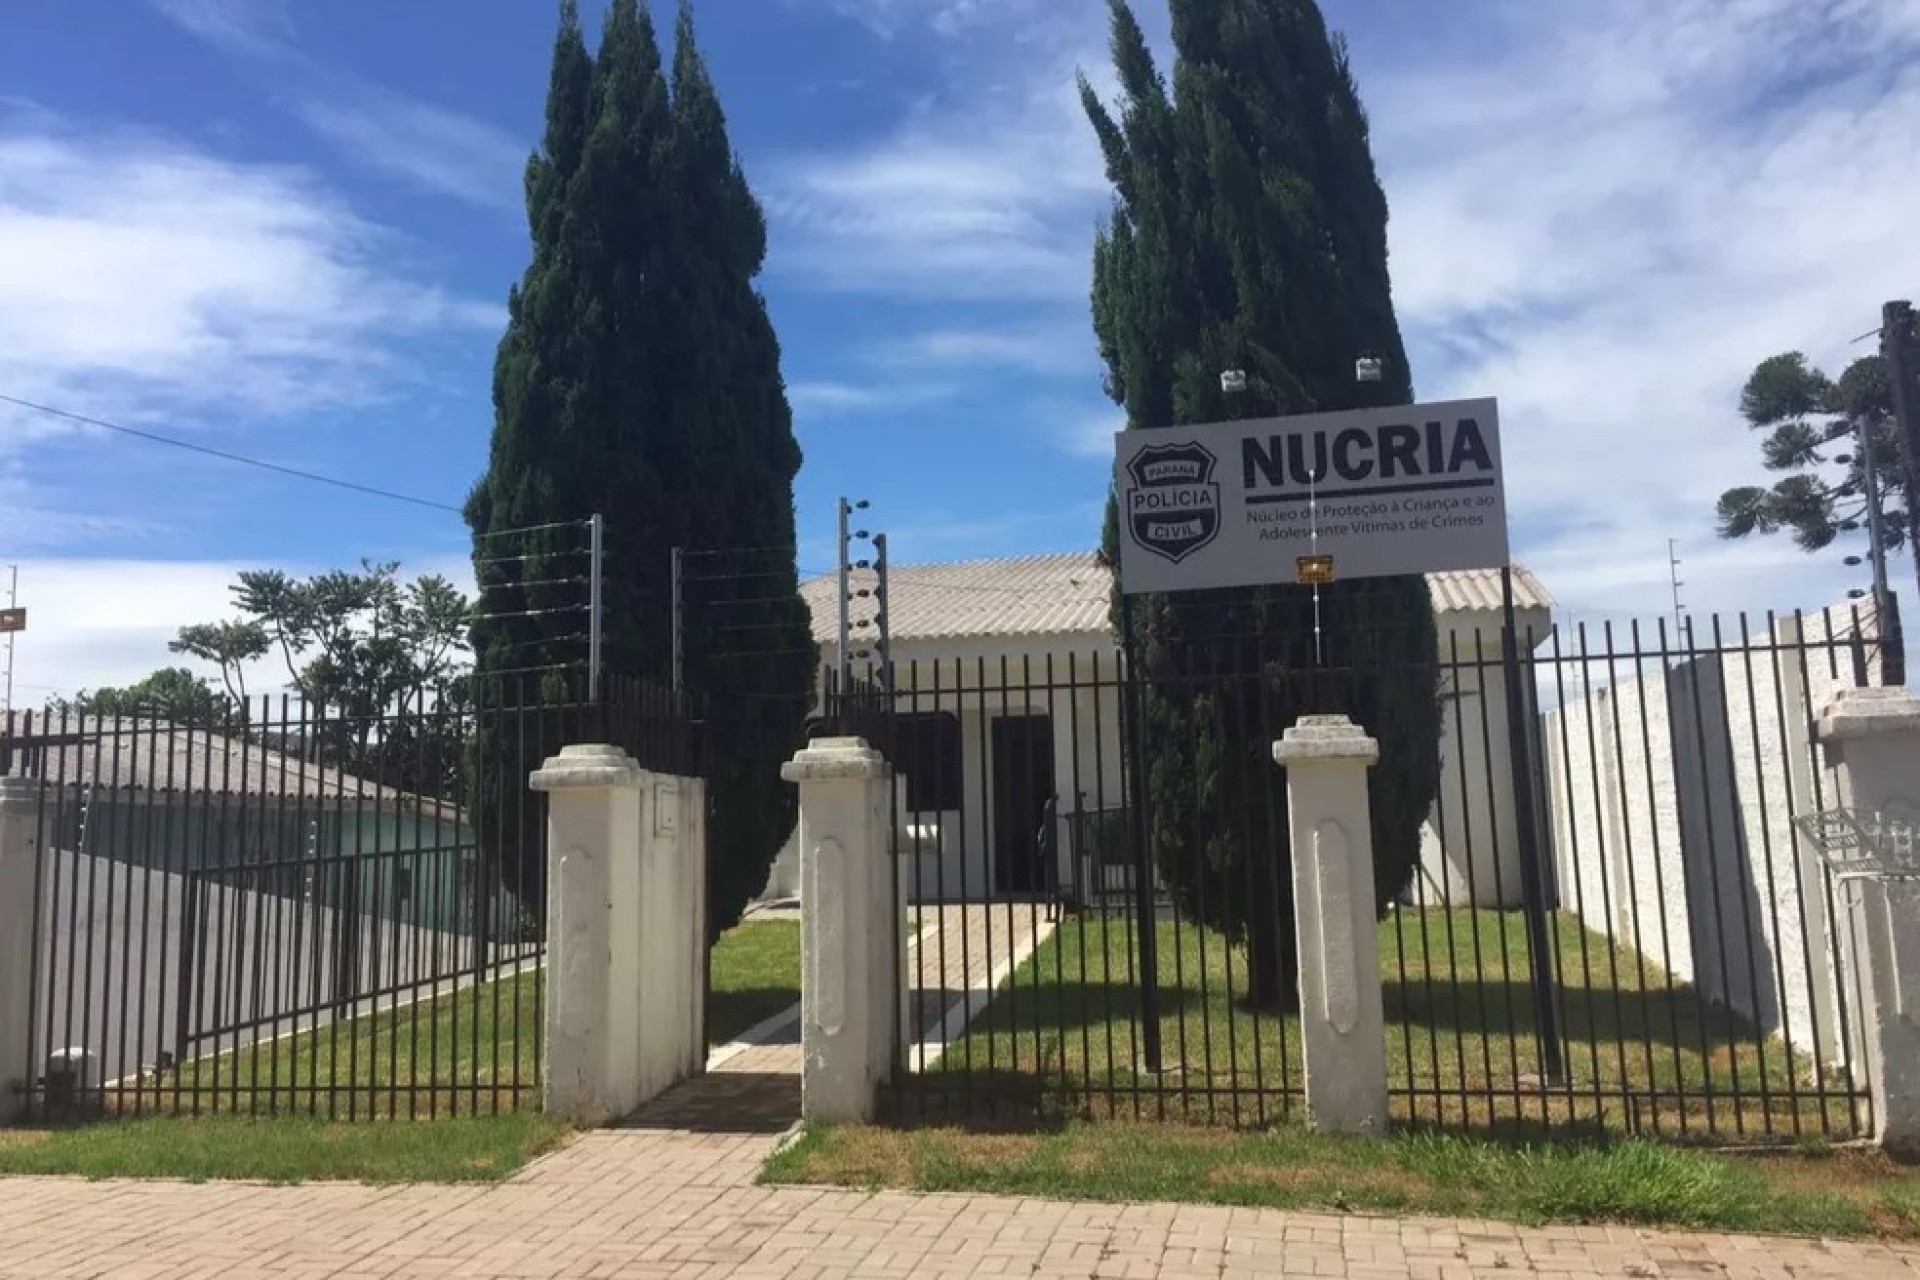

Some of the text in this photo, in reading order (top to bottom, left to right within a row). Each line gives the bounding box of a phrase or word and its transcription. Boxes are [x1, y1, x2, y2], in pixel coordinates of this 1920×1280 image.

[1241, 418, 1493, 488] NUCRIA
[1322, 500, 1388, 518] Proteção
[1402, 498, 1459, 512] Criança
[1463, 497, 1472, 508] e
[1474, 495, 1495, 507] ao
[1154, 525, 1197, 538] CIVIL
[1408, 518, 1429, 530] de
[1431, 514, 1484, 529] Crimes
